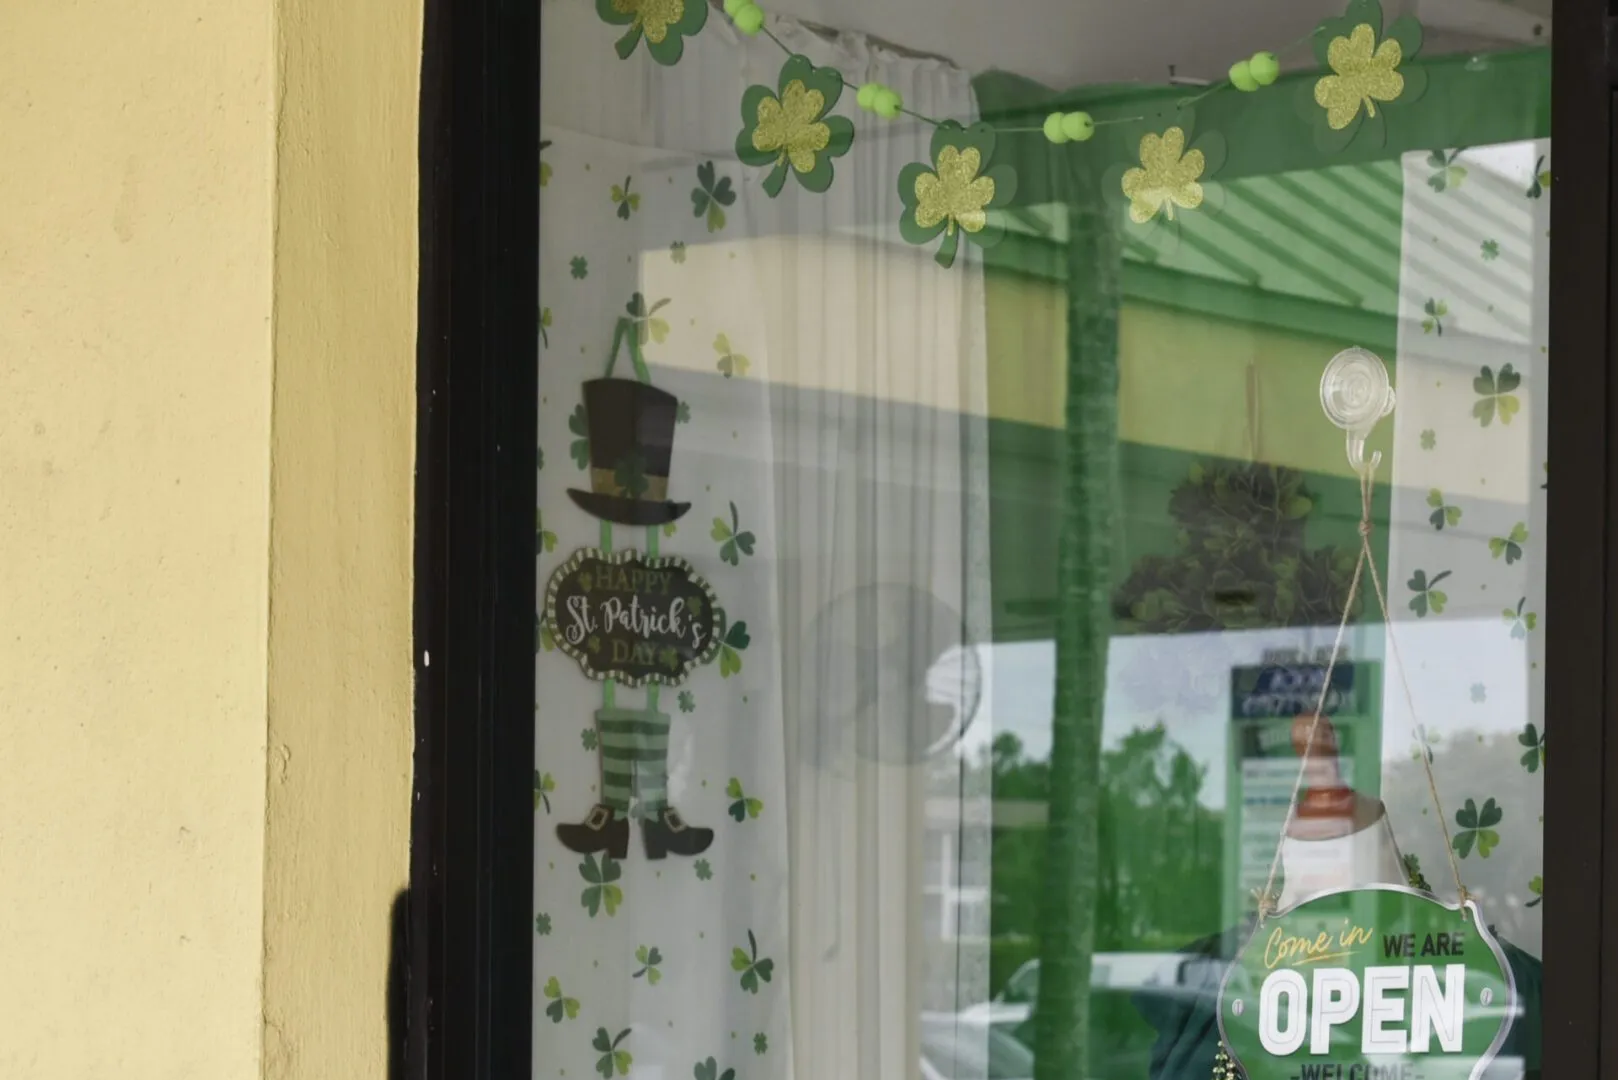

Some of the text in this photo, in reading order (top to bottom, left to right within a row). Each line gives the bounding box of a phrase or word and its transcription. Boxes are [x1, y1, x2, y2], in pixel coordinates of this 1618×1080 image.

[595, 565, 674, 594] HAPPY
[566, 594, 707, 650] St. Patrick's
[612, 639, 660, 666] DAY
[1263, 917, 1373, 968] Come in
[1383, 931, 1465, 958] WE ARE
[1258, 963, 1466, 1056] OPEN
